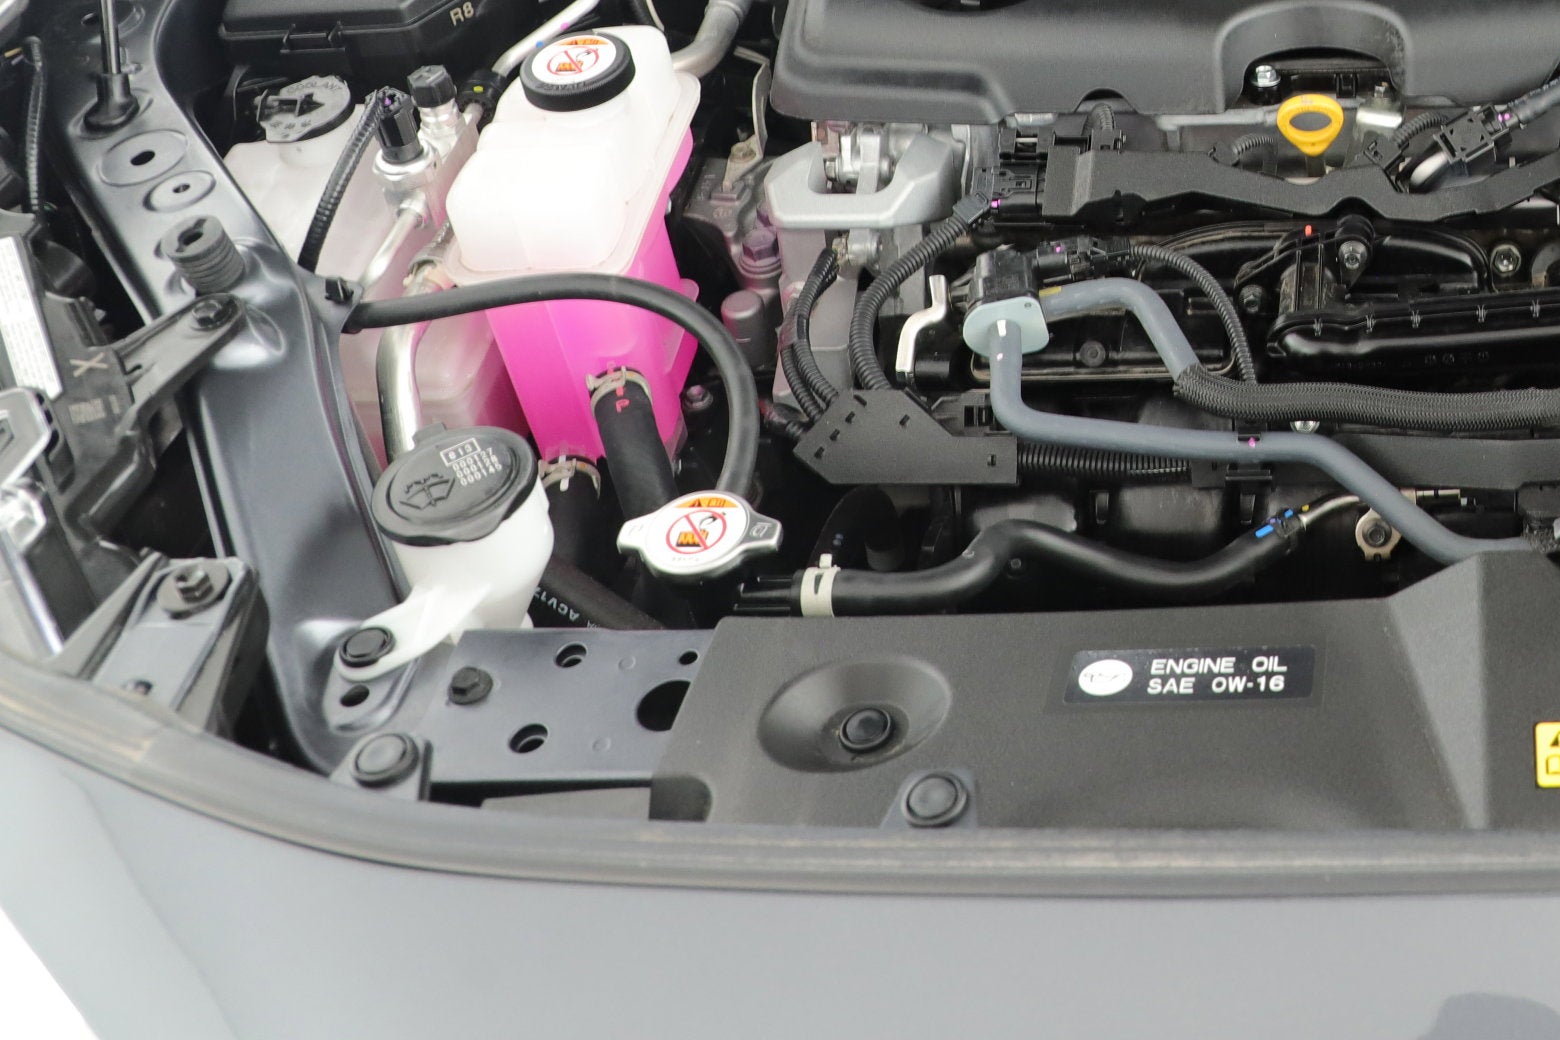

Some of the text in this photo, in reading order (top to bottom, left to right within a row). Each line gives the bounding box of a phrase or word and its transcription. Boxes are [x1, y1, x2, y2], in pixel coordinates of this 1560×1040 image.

[449, 1, 475, 27] R8
[1150, 656, 1288, 676] ENGINE OIL
[1146, 675, 1285, 695] SAE 0W-16
